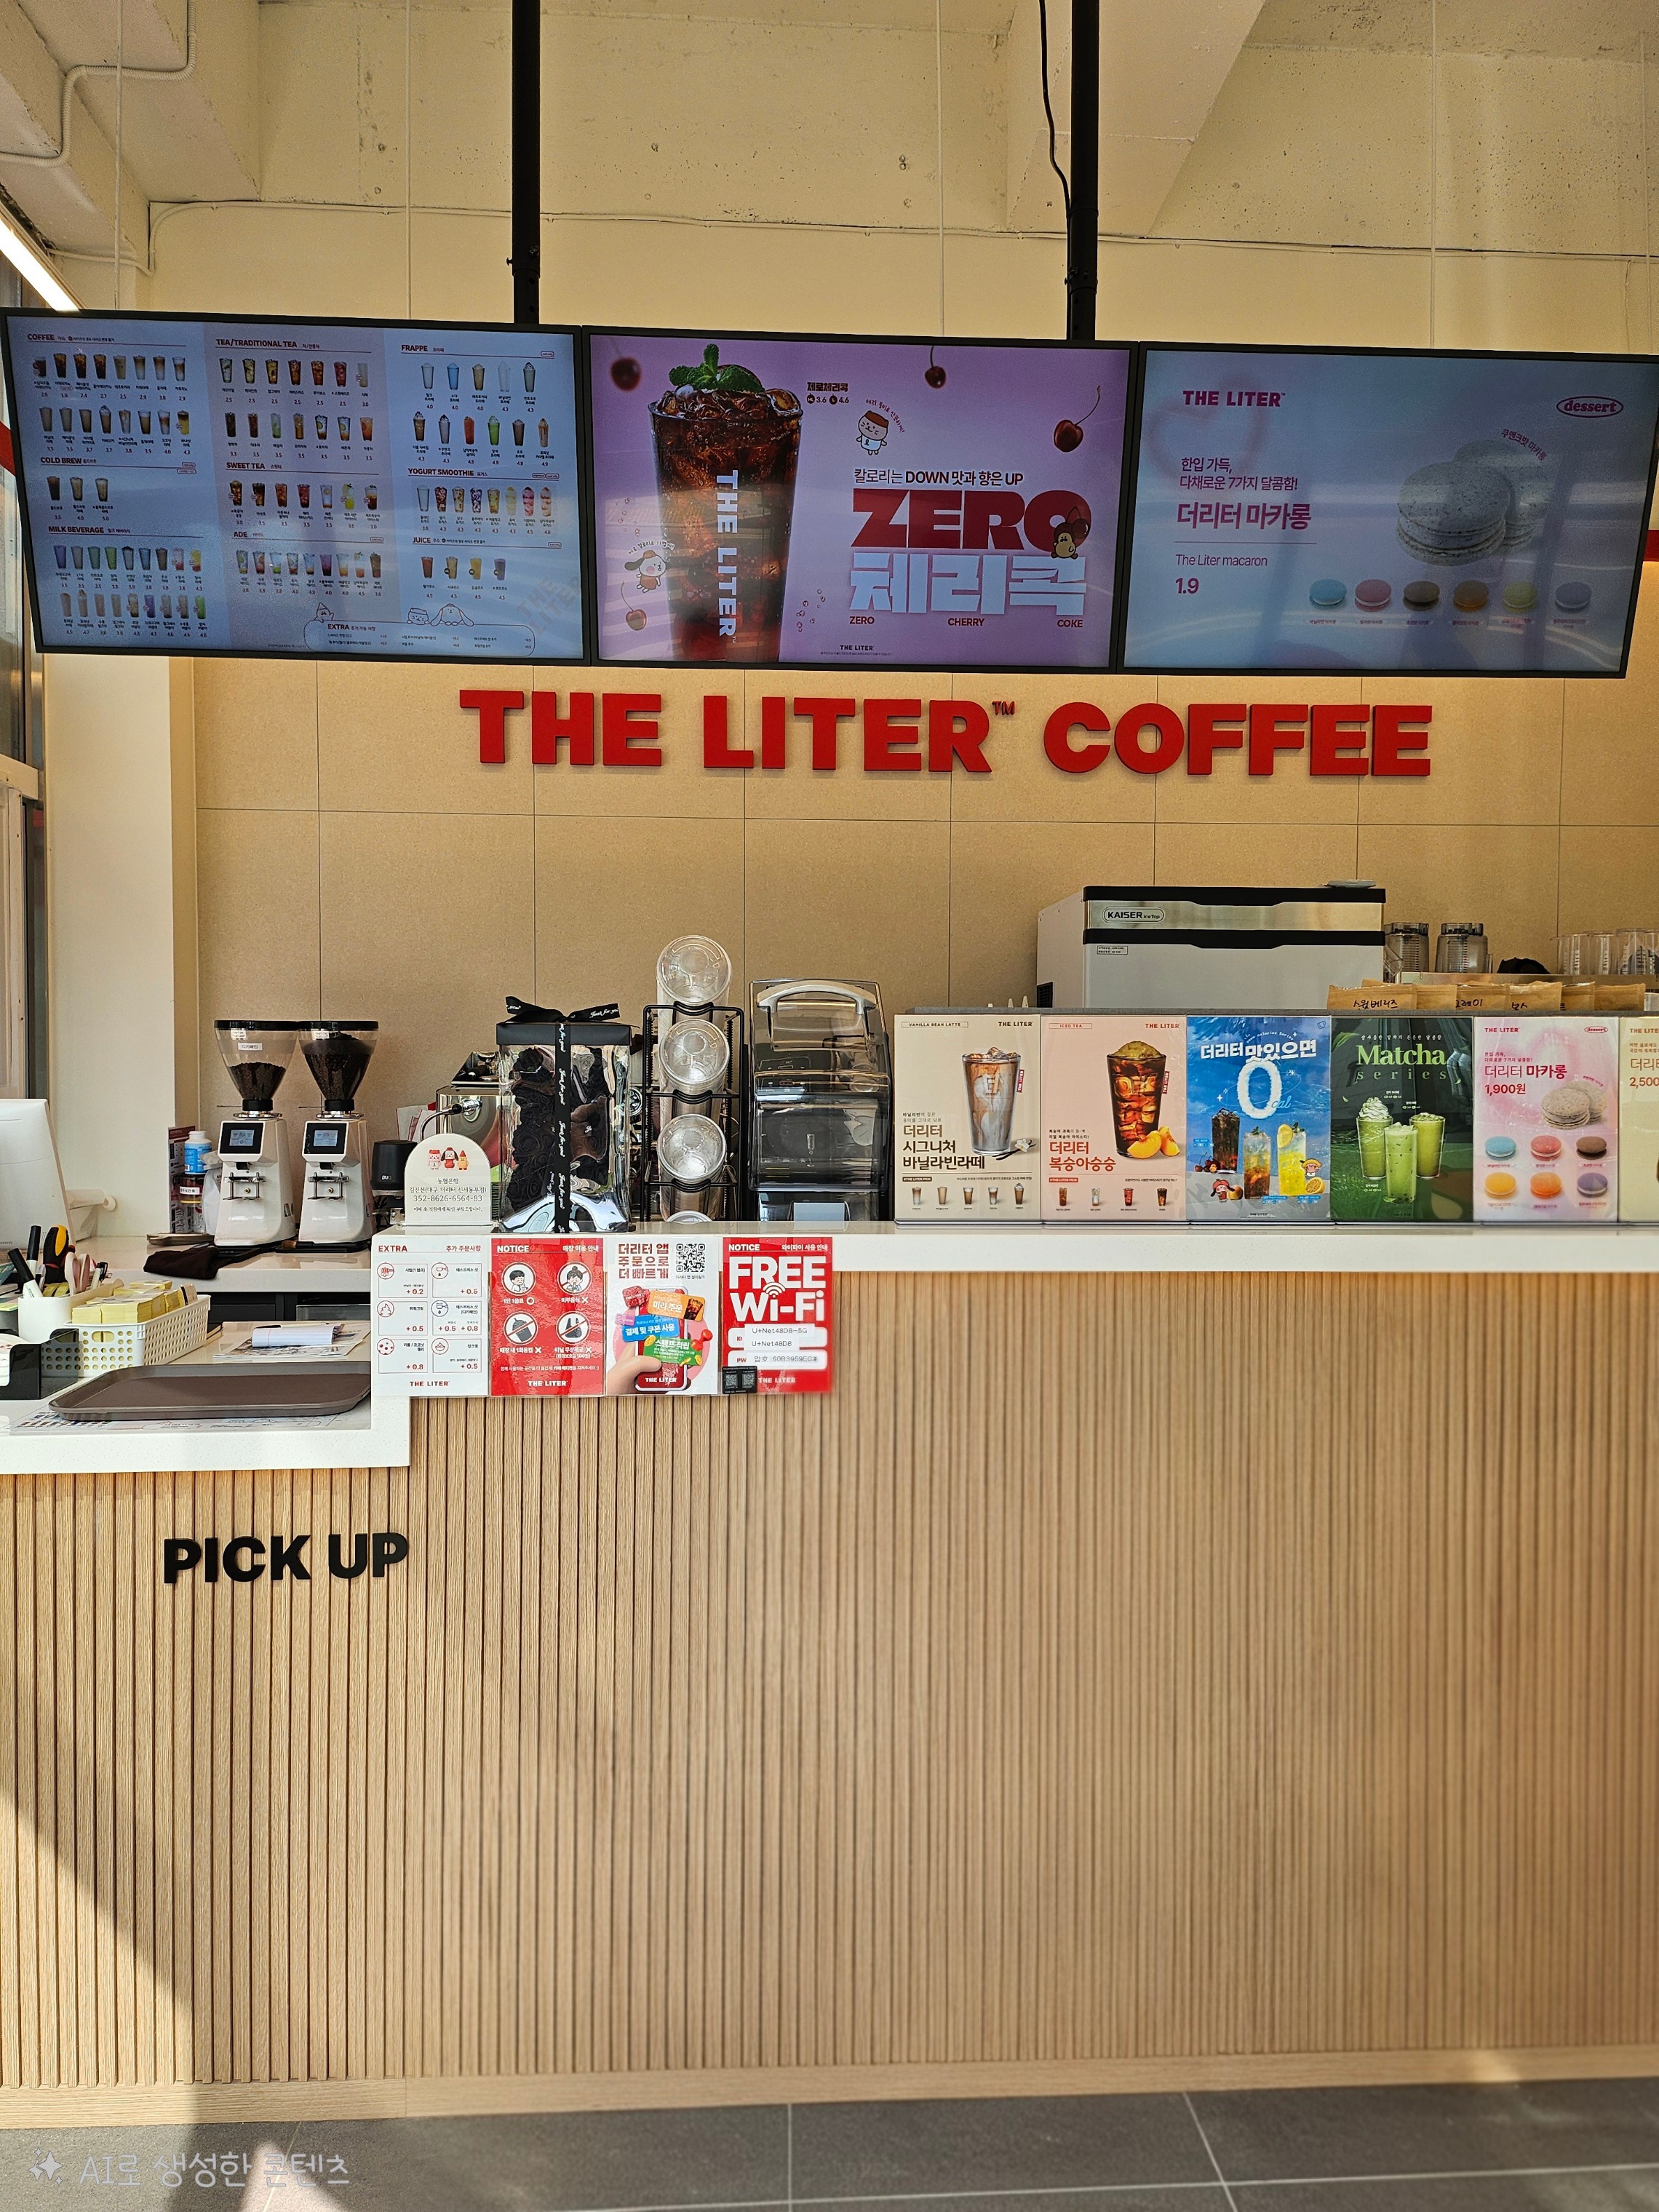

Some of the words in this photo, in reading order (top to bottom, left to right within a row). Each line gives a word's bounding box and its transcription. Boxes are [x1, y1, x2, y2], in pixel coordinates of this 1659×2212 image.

[216, 338, 282, 347] TEA/TRADITIONAL
[1182, 390, 1220, 406] THE
[1226, 391, 1281, 407] LITER
[1564, 400, 1617, 413] dessert
[1181, 457, 1204, 472] 한입
[1206, 458, 1232, 474] 가득,
[854, 469, 903, 485] 칼로리는
[905, 471, 950, 485] DOWN
[952, 471, 976, 487] 맛과
[979, 471, 1003, 487] 향은
[1005, 473, 1024, 486] UP
[1179, 474, 1226, 490] 다채로운
[1228, 476, 1258, 490] 7가지
[1261, 476, 1298, 491] 달콤함!
[716, 469, 739, 534] THE
[850, 488, 1091, 552] ZERO
[1177, 502, 1242, 530] 더리터
[1246, 503, 1311, 530] 마카롱
[1176, 554, 1195, 565] The
[1198, 554, 1221, 566] Liter
[1222, 556, 1268, 567] macaron
[717, 546, 738, 637] LITER
[849, 552, 1086, 616] 체리콕
[1175, 577, 1199, 594] 1.9
[849, 616, 875, 625] ZERO
[947, 617, 985, 627] CHERRY
[1057, 618, 1083, 628] COKE
[459, 689, 662, 766] THE
[703, 695, 992, 773] LITER
[1043, 701, 1433, 776] COFFEE
[1107, 911, 1143, 919] KAISER
[1201, 1042, 1244, 1059] 더리터
[1245, 1039, 1316, 1063] 맛있으면
[1356, 1043, 1448, 1065] Matcha
[1356, 1068, 1447, 1080] series
[1484, 1065, 1522, 1078] 더리터
[1526, 1065, 1567, 1080] 마카롱
[1237, 1059, 1283, 1120] 0
[1271, 1095, 1292, 1109] cal
[1484, 1083, 1526, 1097] 1,900원
[903, 1124, 942, 1138] 더리터
[902, 1139, 956, 1153] 시그니처
[1049, 1141, 1089, 1155] 더리터
[903, 1155, 985, 1170] 바닐라빈라떼
[1049, 1156, 1117, 1171] 복숭아숭숭
[618, 1244, 653, 1254] 더리터
[656, 1244, 669, 1254] 앱
[618, 1256, 669, 1267] 주문으로
[618, 1268, 629, 1279] 더
[632, 1268, 669, 1279] 빠르게
[729, 1256, 827, 1289] FREE
[653, 1301, 667, 1310] 미리
[669, 1303, 683, 1313] 주문
[729, 1290, 824, 1321] Wi-Fi
[625, 1327, 639, 1336] 결제
[640, 1326, 647, 1334] 및
[648, 1325, 661, 1334] 쿠폰
[661, 1323, 675, 1332] 사용
[654, 1339, 675, 1349] 스탬프
[676, 1341, 690, 1350] 적립
[164, 1535, 312, 1584] PICK
[327, 1532, 409, 1579] UP
